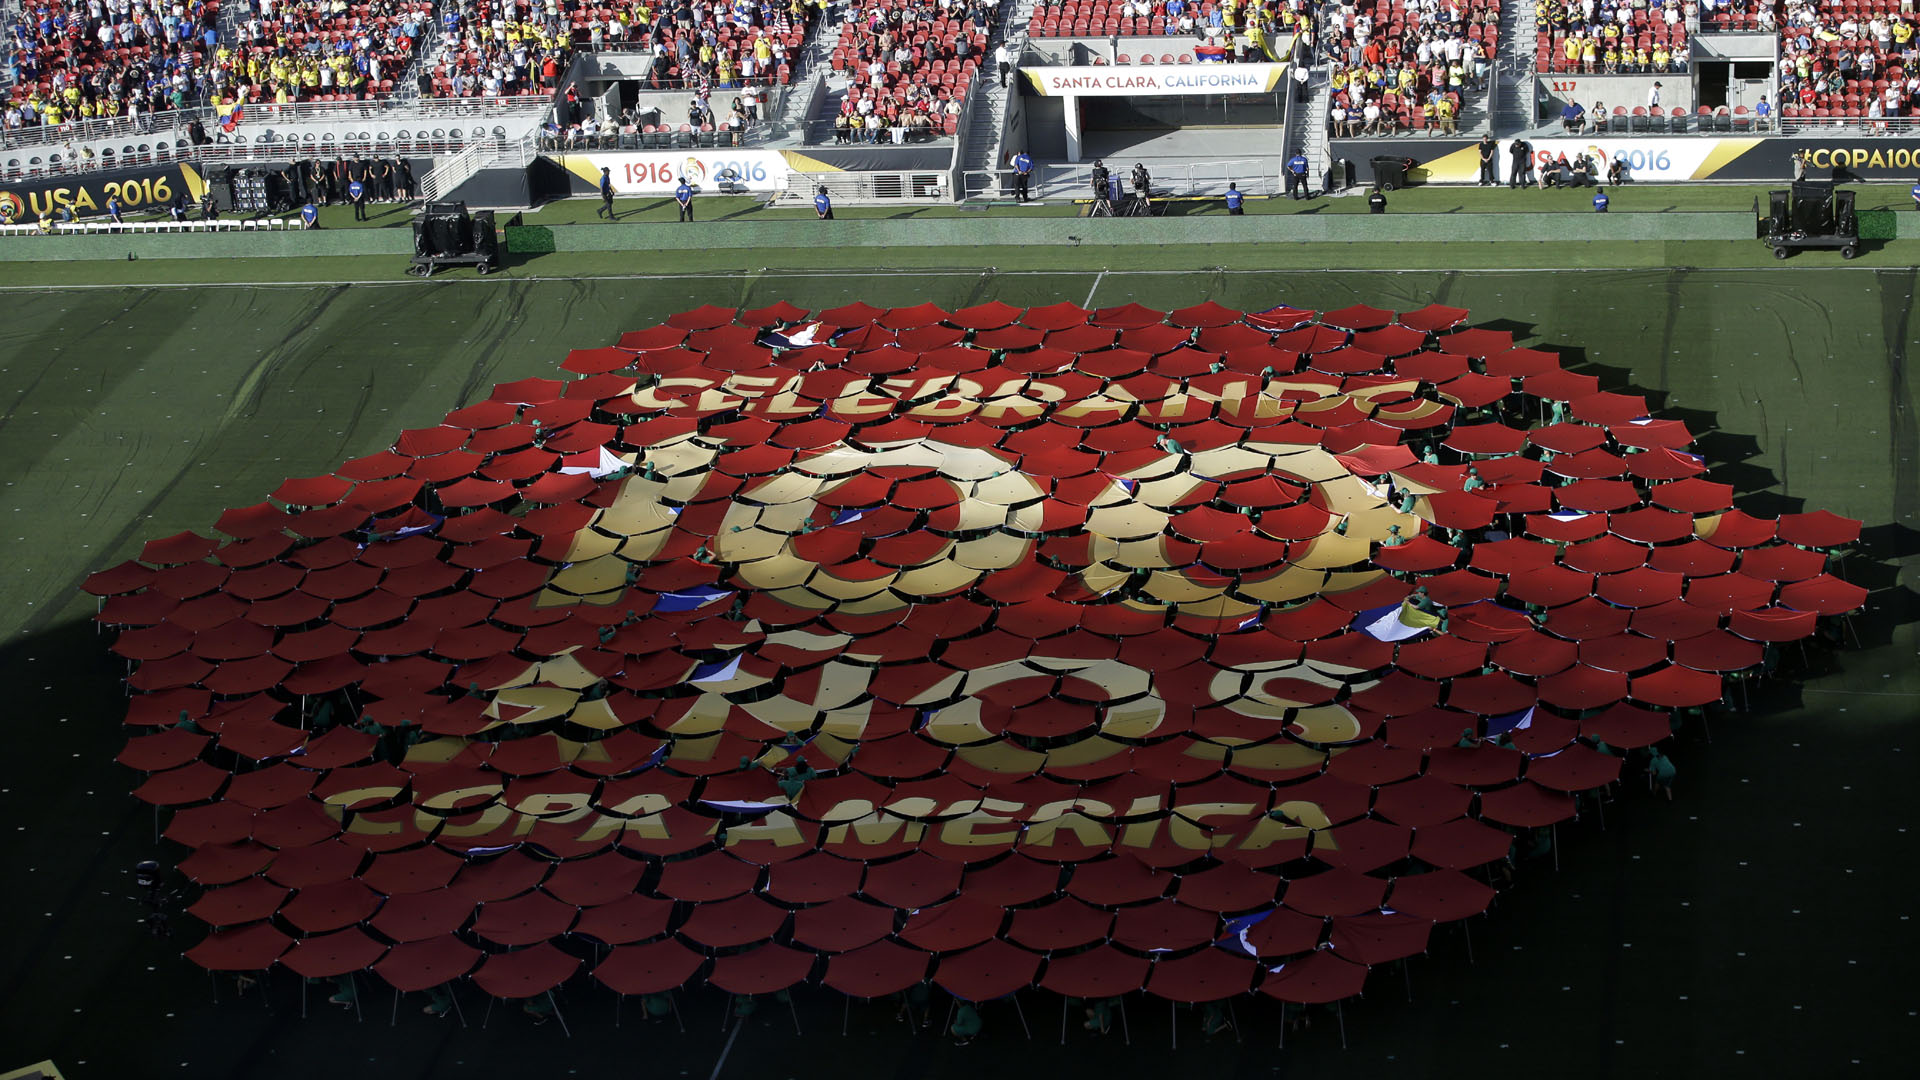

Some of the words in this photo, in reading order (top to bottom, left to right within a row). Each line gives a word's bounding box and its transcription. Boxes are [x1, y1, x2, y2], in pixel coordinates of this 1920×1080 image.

[1053, 77, 1102, 89] SANTA
[1109, 76, 1161, 90] CLARA,
[1165, 74, 1258, 88] CALIFORNIA
[1553, 82, 1577, 92] 117
[624, 162, 673, 184] 1916
[712, 160, 766, 182] 2016
[1614, 149, 1671, 171] 2016
[28, 186, 98, 216] USA
[104, 176, 172, 209] 2016
[616, 374, 1463, 421] CELEBRANDO
[530, 431, 1436, 620] 100
[323, 784, 672, 841] COPA
[705, 794, 1339, 850] AMERICA
